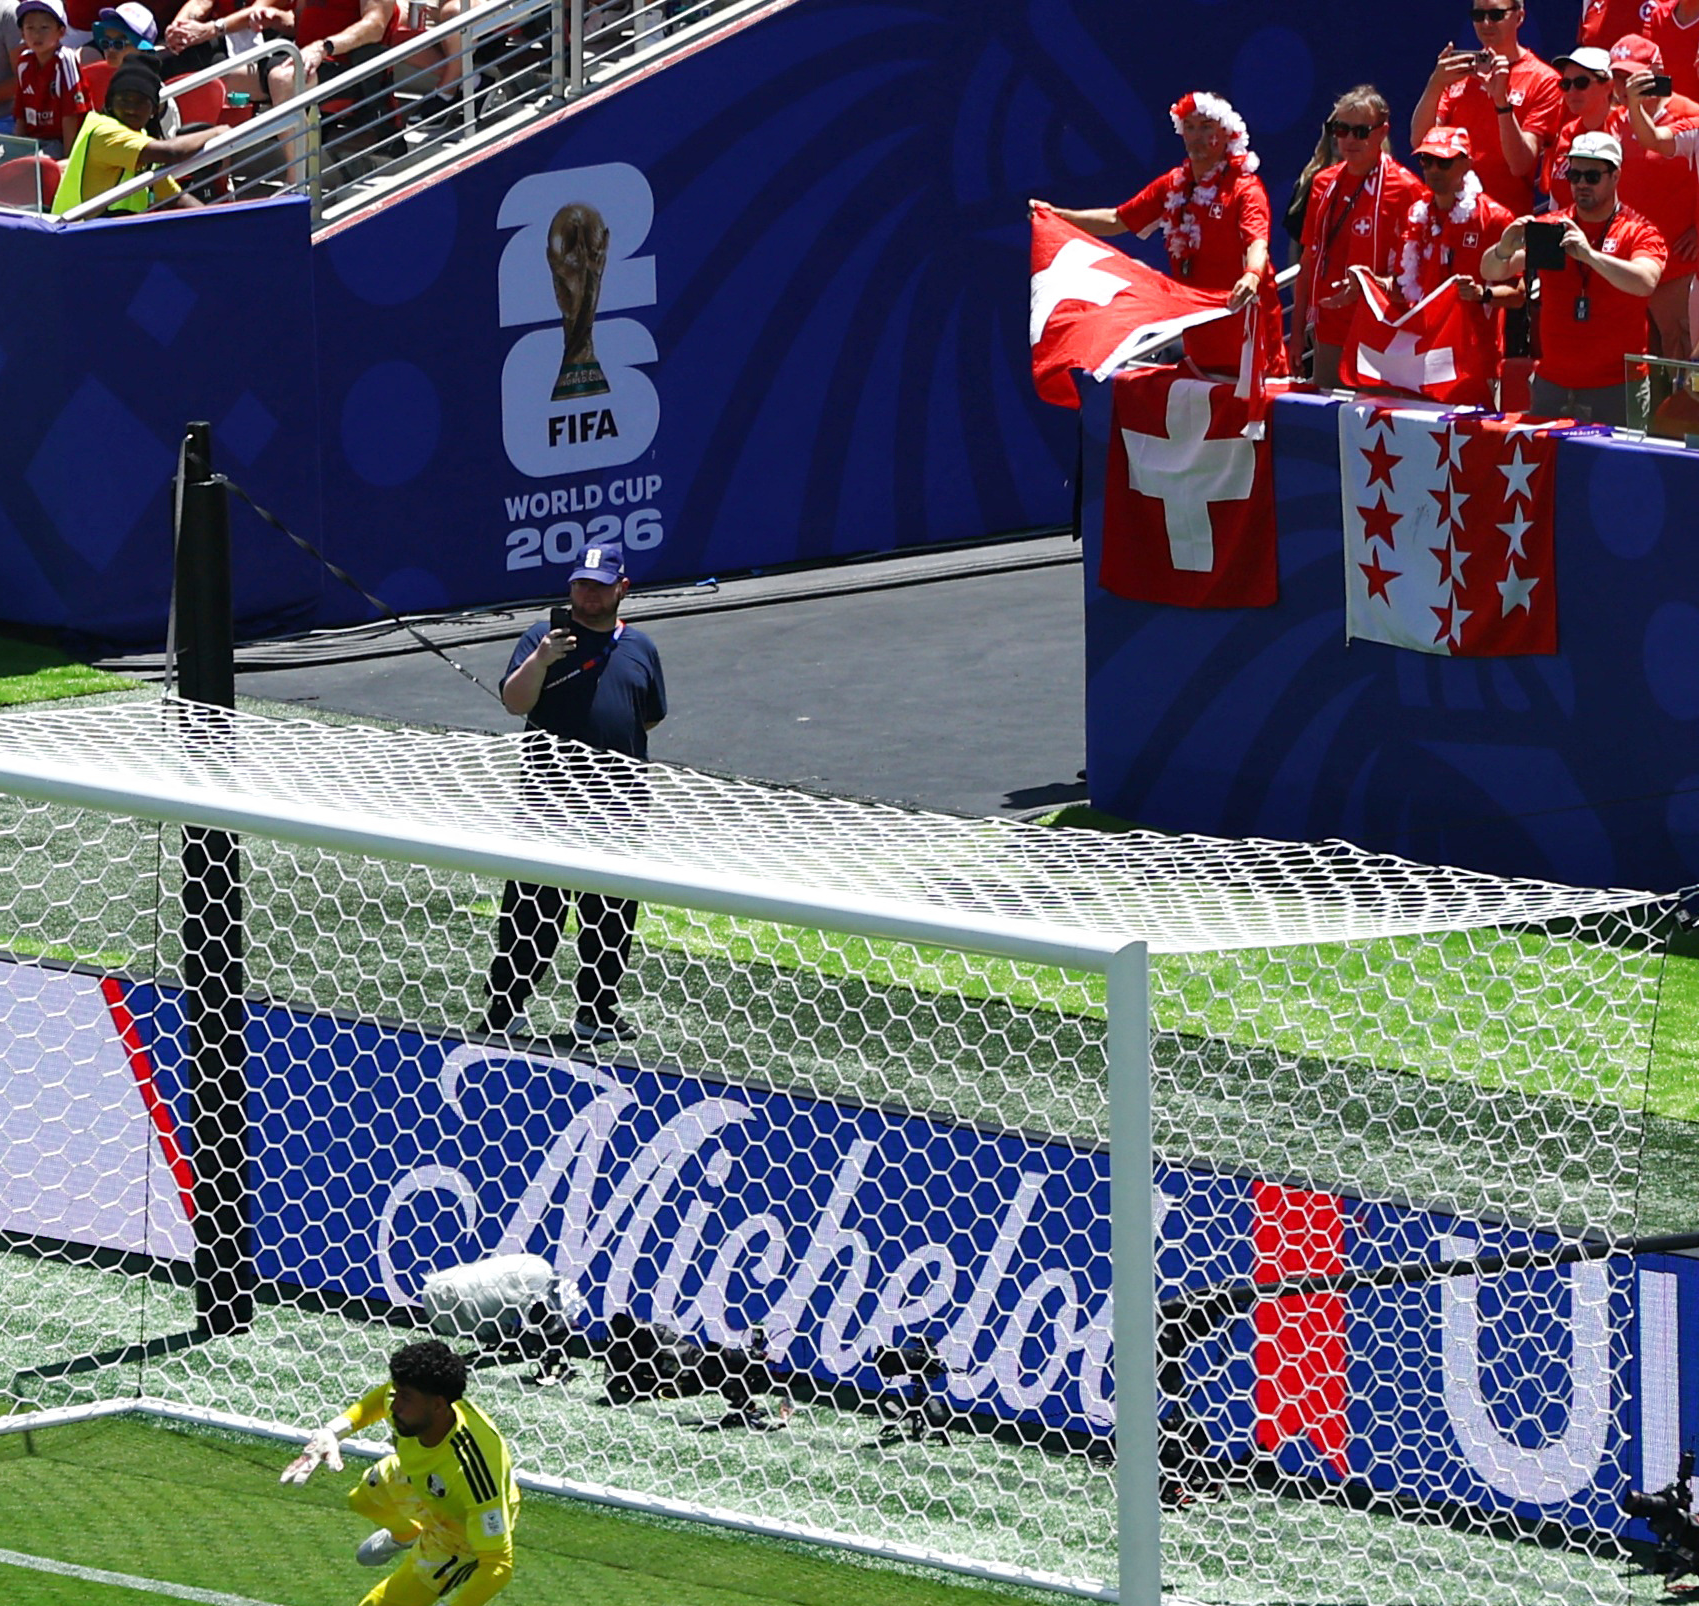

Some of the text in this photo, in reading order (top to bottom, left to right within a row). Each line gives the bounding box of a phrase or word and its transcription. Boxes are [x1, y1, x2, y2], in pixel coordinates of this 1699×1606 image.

[548, 409, 619, 447] FIFA
[504, 474, 663, 522] WORLD CUP
[506, 508, 664, 572] 2026
